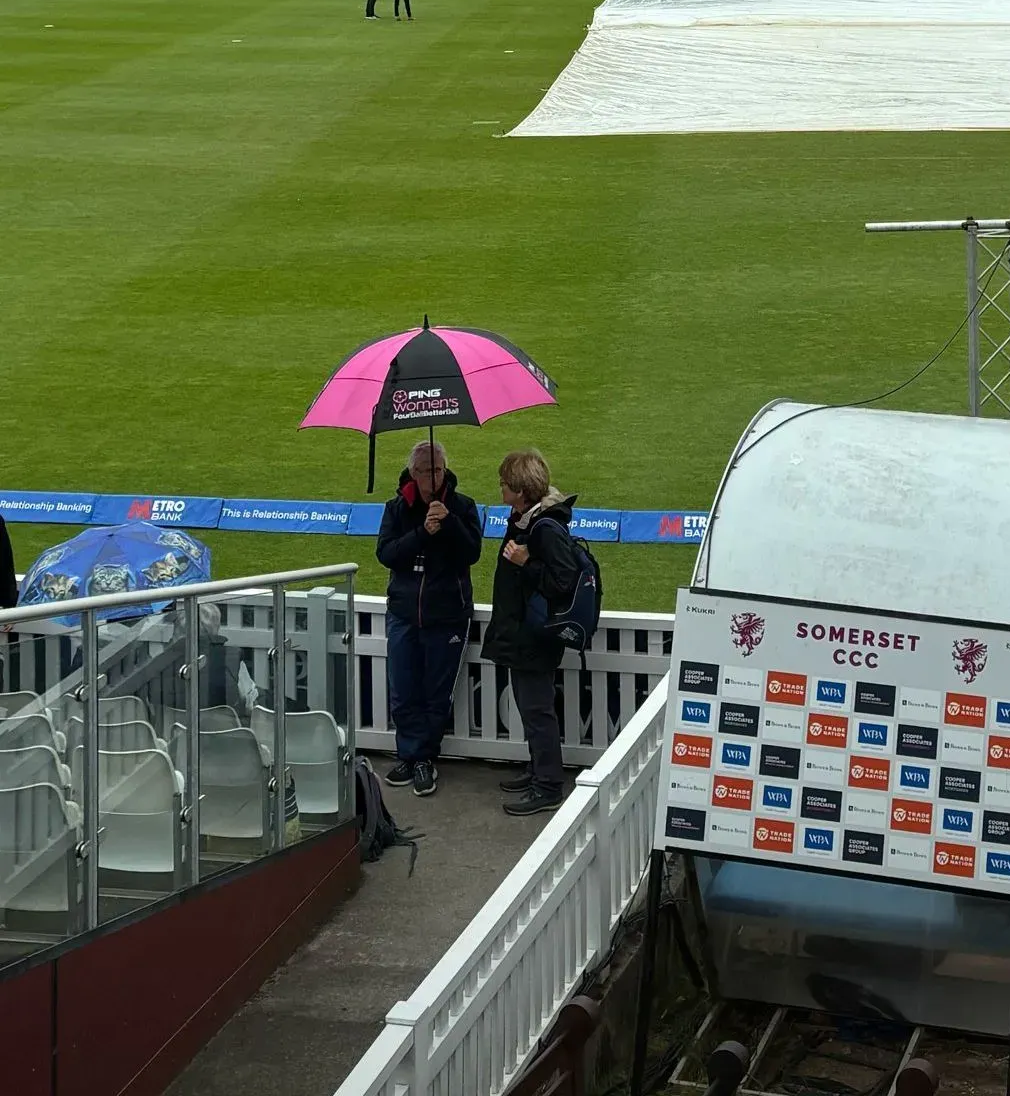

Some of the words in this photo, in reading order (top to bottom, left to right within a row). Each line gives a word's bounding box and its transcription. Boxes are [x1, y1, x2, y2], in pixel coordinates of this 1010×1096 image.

[408, 388, 442, 399] PING
[0, 500, 55, 511] Relationship
[56, 501, 92, 513] Banking
[151, 512, 182, 521] BANK
[222, 508, 241, 518] This
[242, 509, 250, 518] is
[252, 509, 308, 521] Relationship
[311, 511, 347, 523] Banking
[488, 516, 508, 526] This
[580, 519, 617, 530] Banking
[658, 515, 708, 538] METR
[684, 528, 705, 538] BAN
[692, 607, 716, 615] KUKRI
[796, 622, 921, 651] SOMERSET
[833, 649, 879, 669] CCC
[820, 686, 841, 697] WPA
[686, 706, 706, 717] WPA
[862, 728, 883, 739] WPA
[726, 748, 747, 759] WPA
[904, 771, 926, 782] WPA
[767, 791, 788, 802] WPA
[947, 814, 969, 826] WPA
[809, 834, 830, 845] WPA
